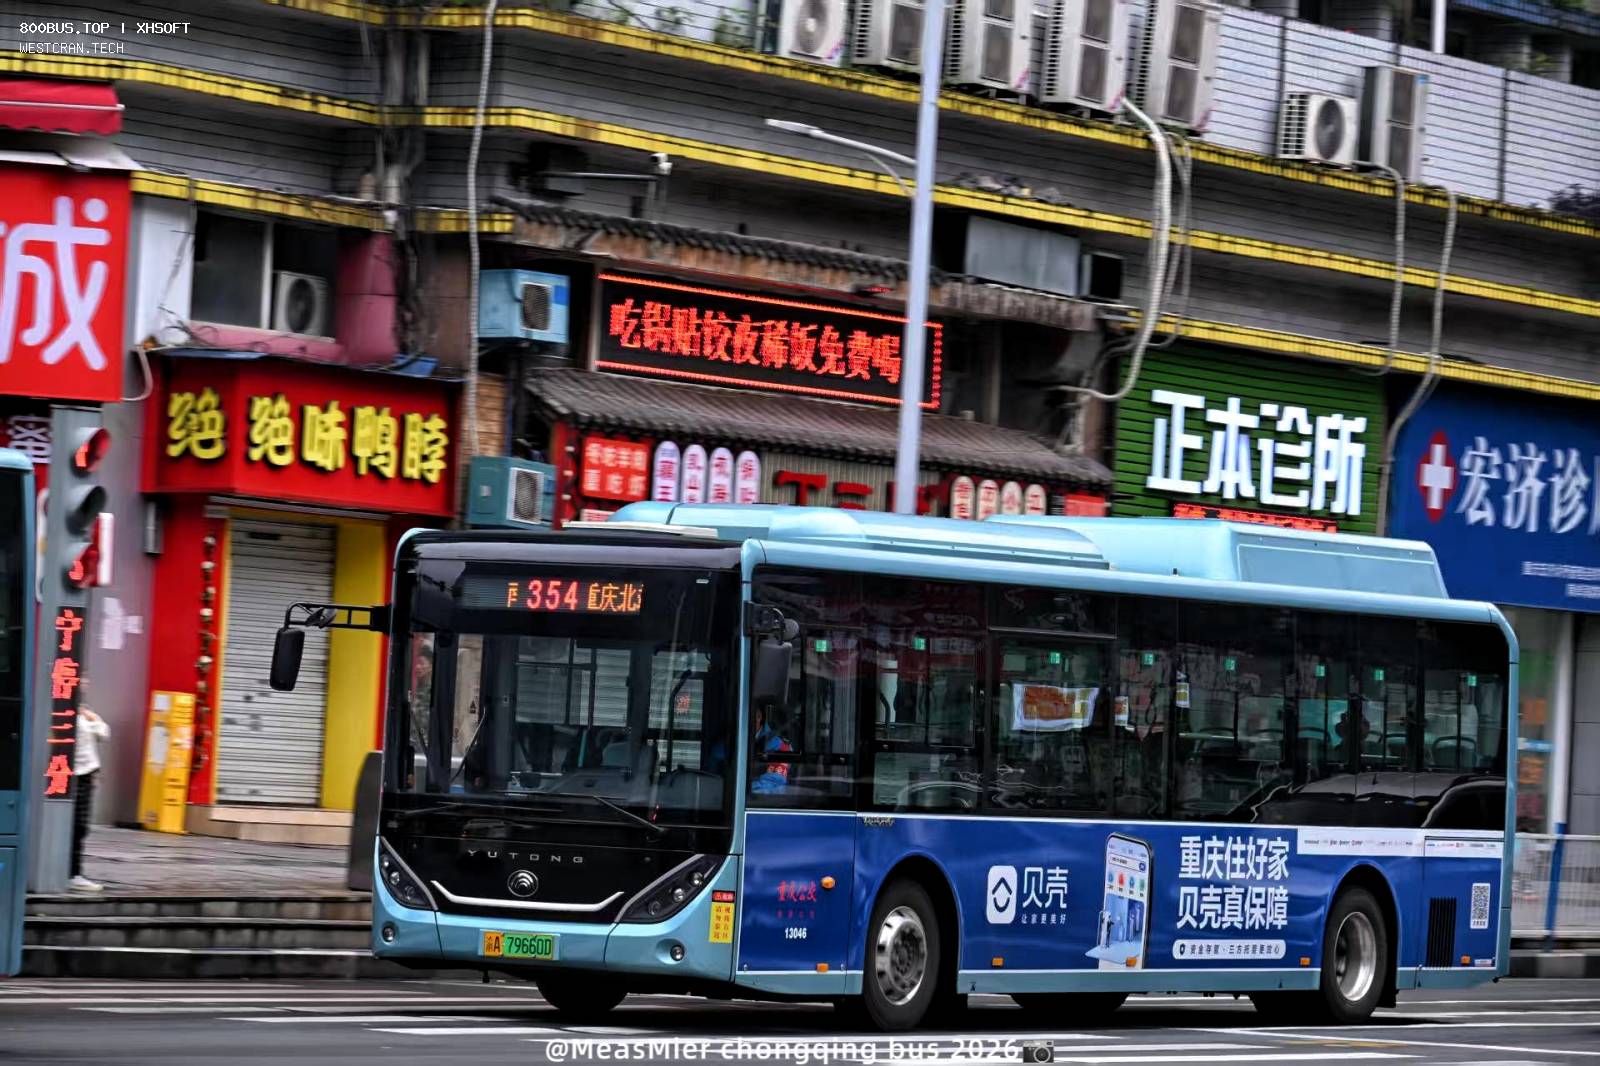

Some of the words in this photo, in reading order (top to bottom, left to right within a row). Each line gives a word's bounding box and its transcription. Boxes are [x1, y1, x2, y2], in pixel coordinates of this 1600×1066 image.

[248, 393, 450, 484] 绝味鸭脖
[1146, 389, 1368, 516] 正本诊所
[1455, 435, 1600, 537] 宏济诊
[526, 579, 579, 611] 354
[467, 849, 584, 864] YUTONG
[1178, 834, 1289, 881] 重庆住好家
[1022, 866, 1069, 909] 贝壳
[1176, 884, 1289, 931] 贝壳真保障
[784, 927, 807, 940] 13046
